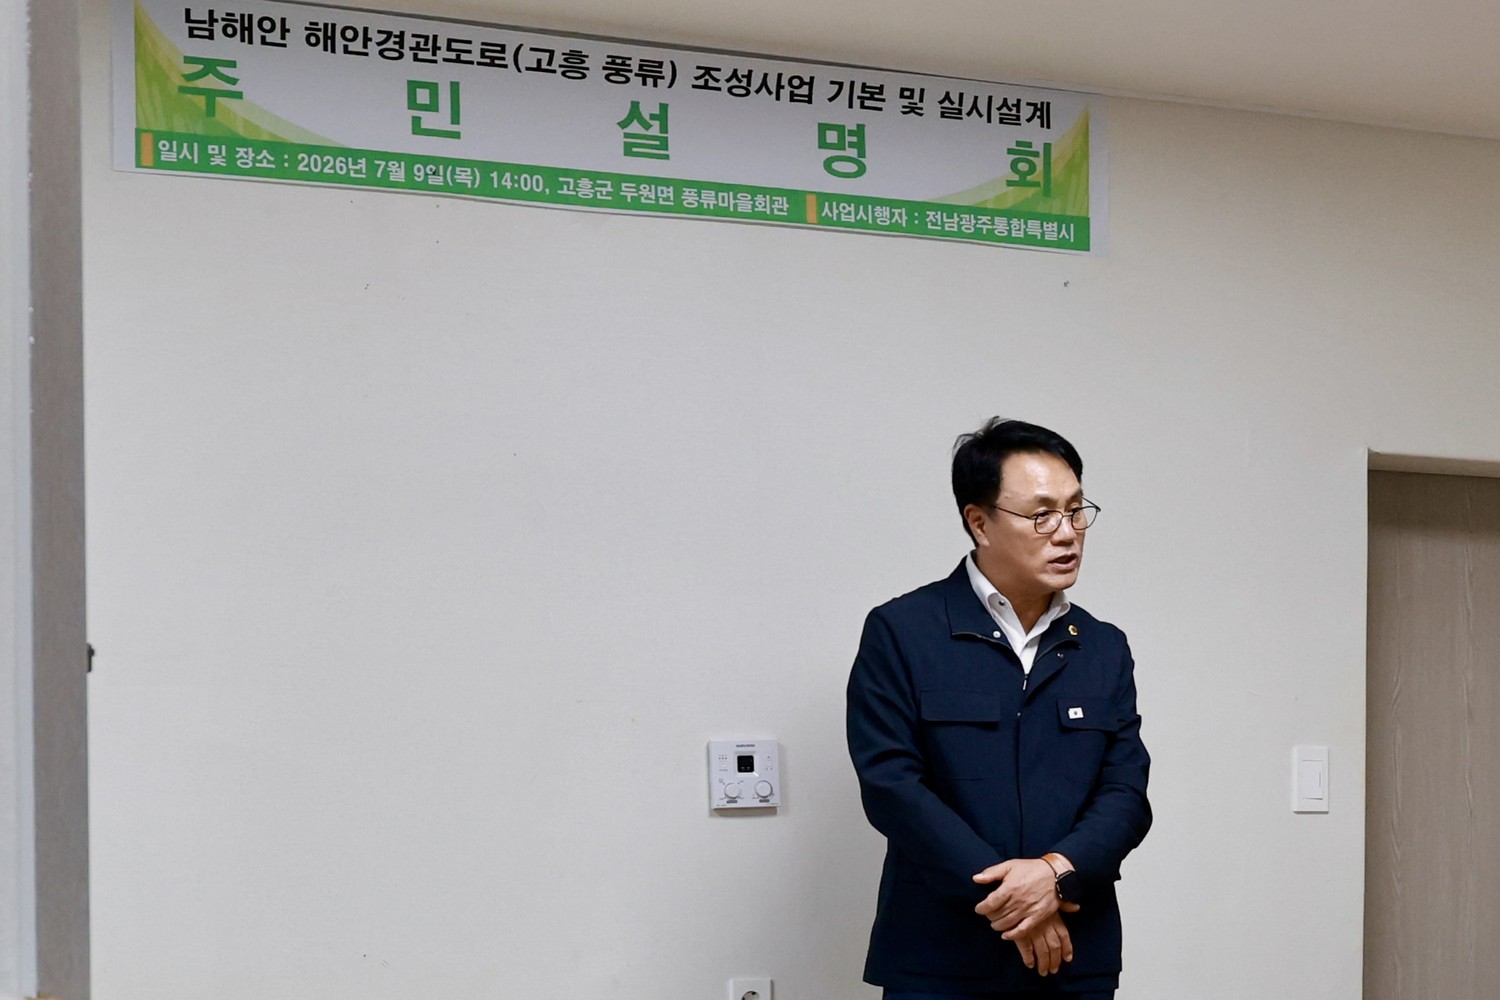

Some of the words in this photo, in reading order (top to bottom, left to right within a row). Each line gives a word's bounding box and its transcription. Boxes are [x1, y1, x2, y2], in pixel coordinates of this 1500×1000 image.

[184, 8, 291, 48] 남해안
[304, 21, 590, 80] 해안경관도로(고흥
[601, 54, 678, 88] 풍류)
[691, 64, 815, 104] 조성사업
[827, 78, 886, 112] 기본
[899, 86, 925, 117] 및
[937, 90, 1053, 129] 실시설계
[177, 55, 243, 118] 주
[406, 79, 461, 139] 민
[616, 100, 671, 161] 설
[816, 121, 867, 179] 명
[1005, 140, 1053, 198] 회
[158, 140, 199, 164] 일시
[207, 144, 227, 166] 및
[235, 147, 276, 169] 장소
[297, 153, 367, 178] 2026년
[374, 160, 406, 182] 7월
[413, 163, 481, 188] 9일(목)
[490, 171, 550, 195] 14:00,
[557, 177, 613, 200] 고흥군
[620, 182, 674, 205] 두원면
[681, 187, 789, 216] 풍류마을회관
[822, 201, 908, 227] 사업시행자
[925, 210, 1075, 242] 전남광주통합특별시
